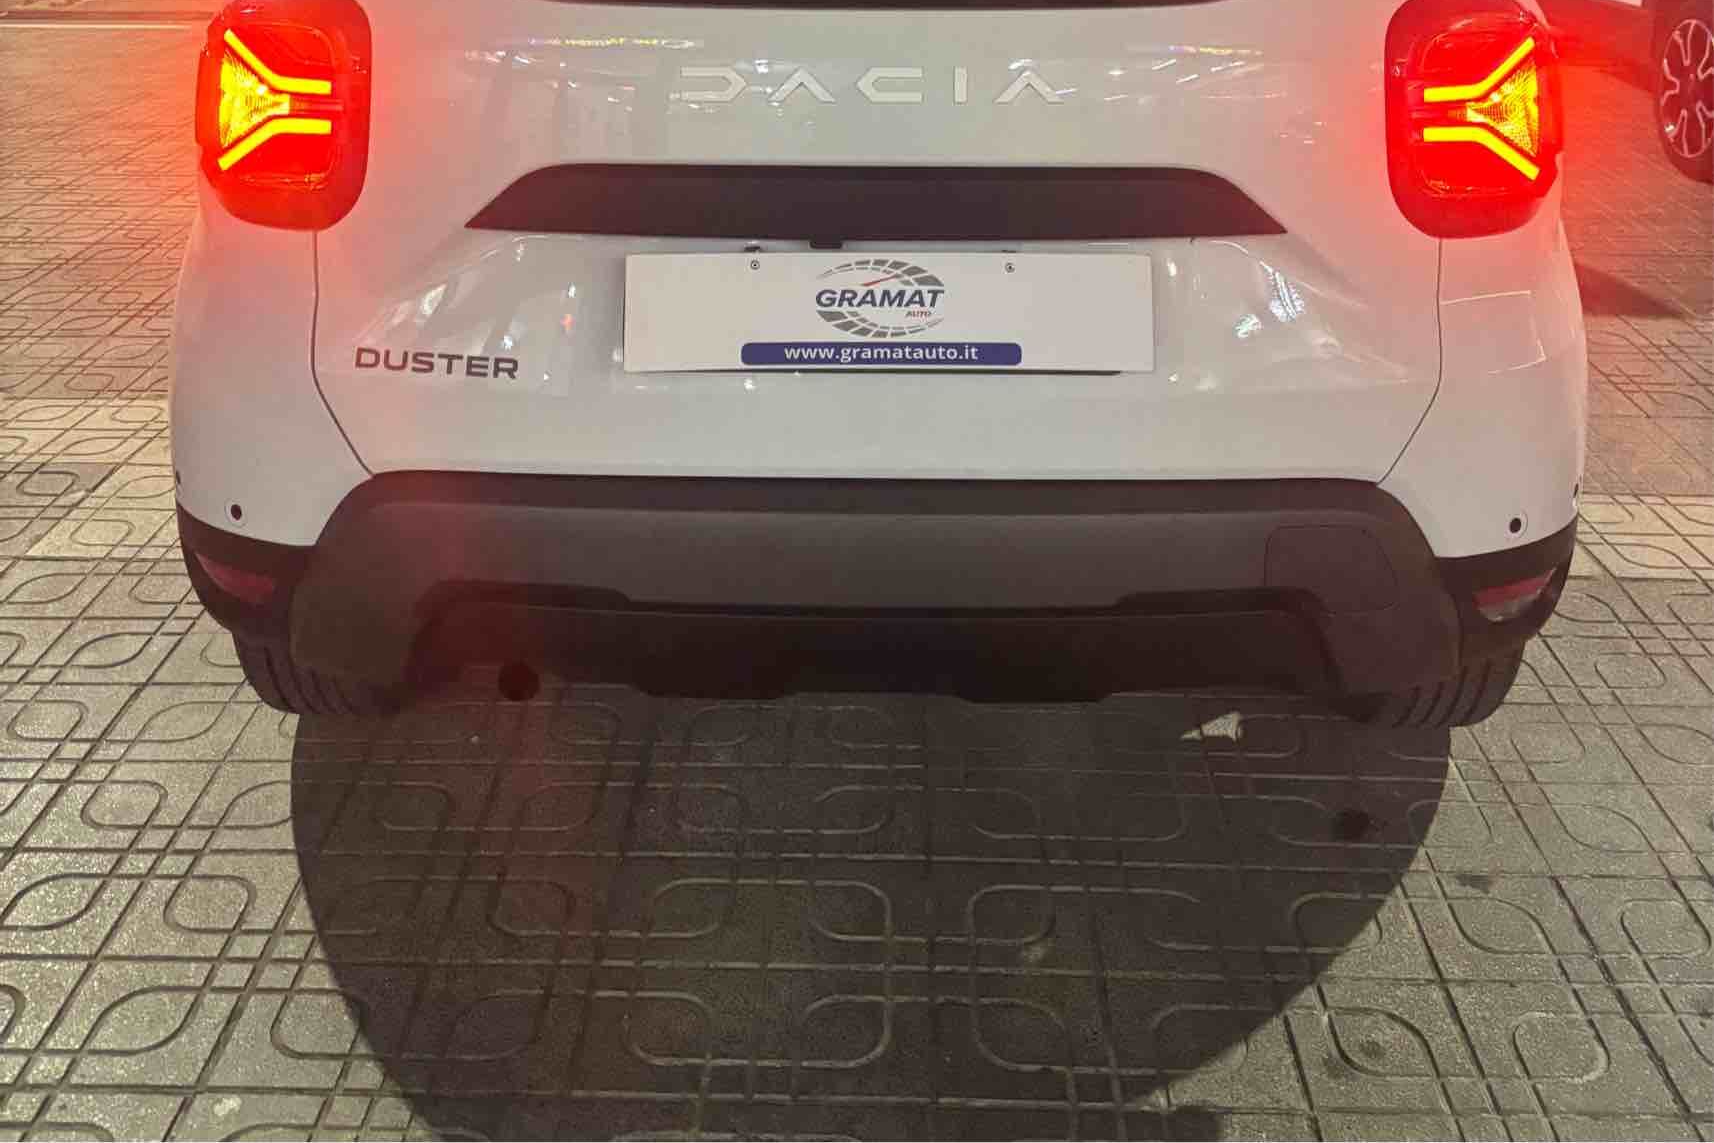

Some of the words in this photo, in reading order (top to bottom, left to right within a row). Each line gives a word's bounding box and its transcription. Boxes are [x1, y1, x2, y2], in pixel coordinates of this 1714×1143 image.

[680, 66, 1065, 104] DACIA
[815, 289, 945, 307] GRAMAT
[354, 347, 519, 380] DUSTER
[784, 344, 978, 362] www.gramatauto.it
